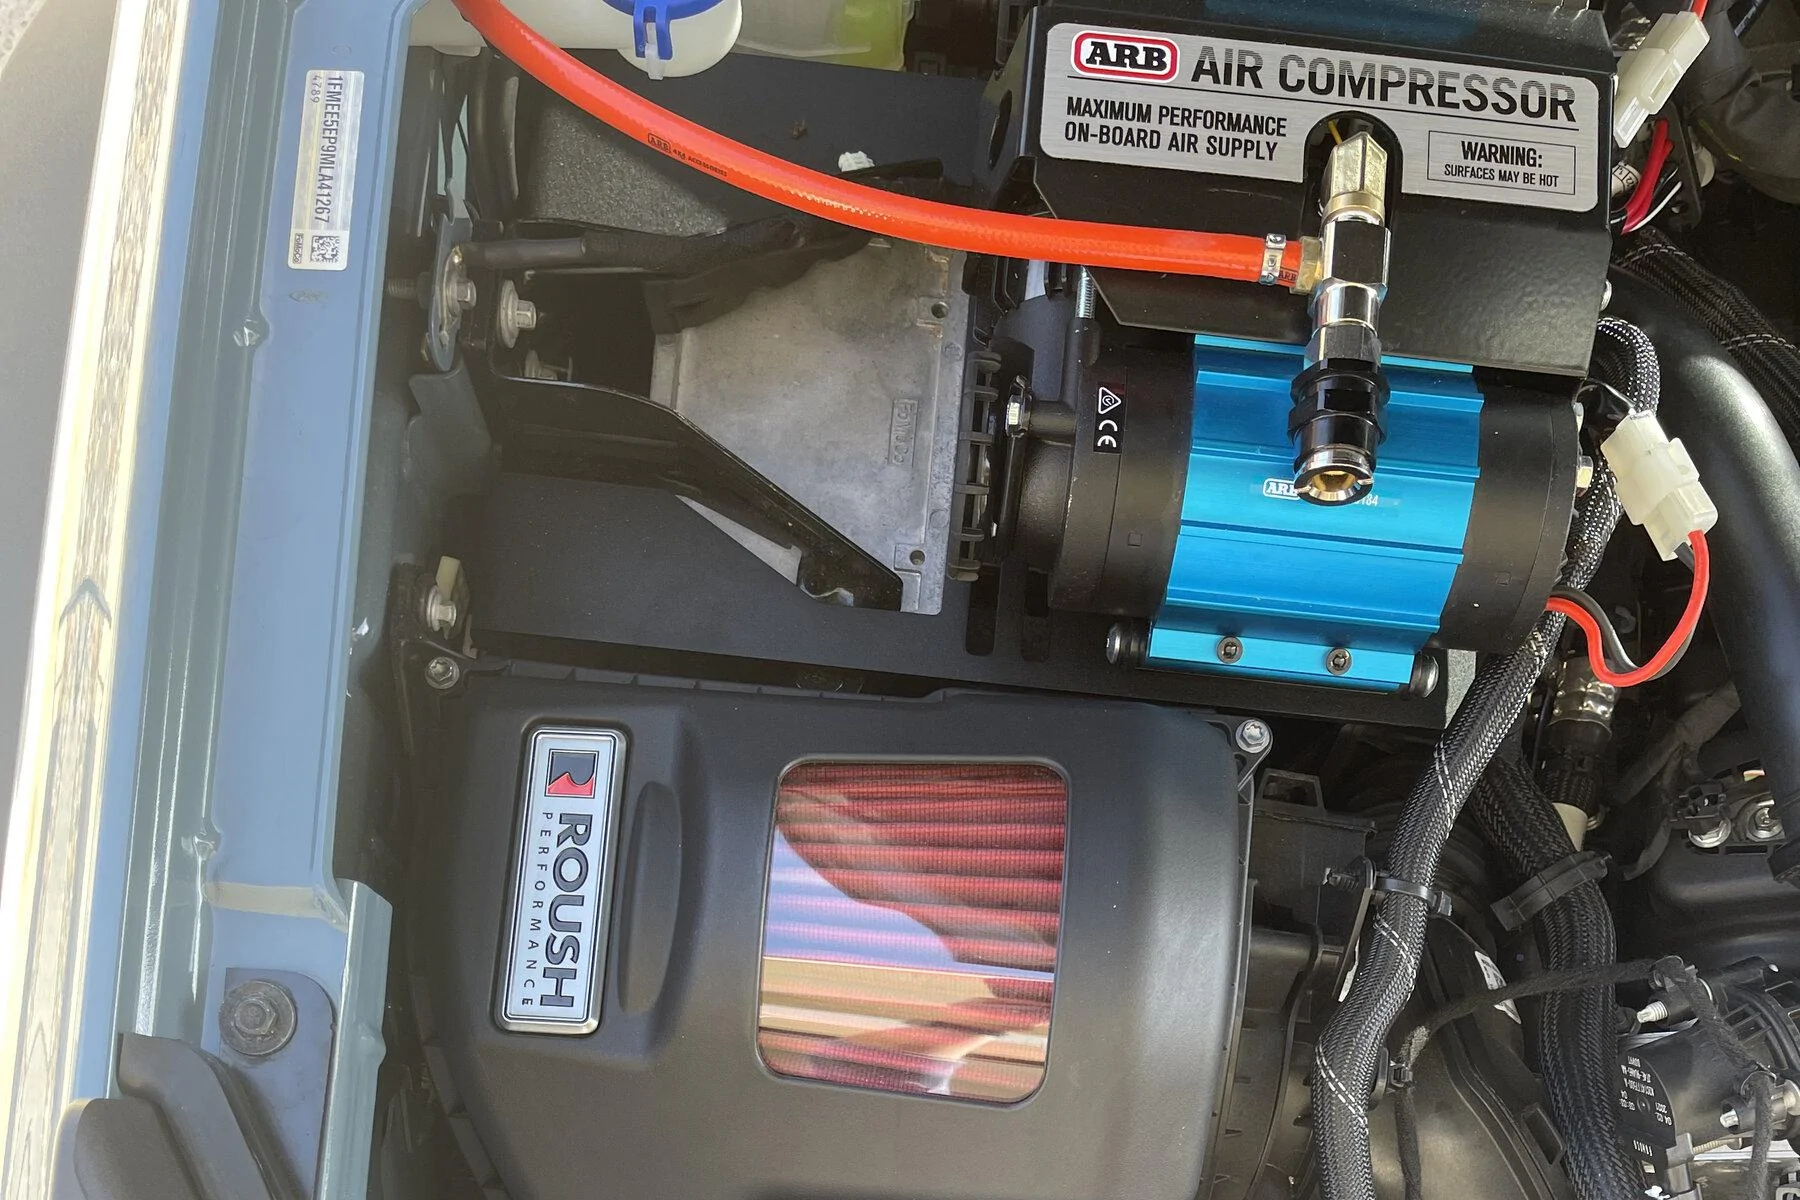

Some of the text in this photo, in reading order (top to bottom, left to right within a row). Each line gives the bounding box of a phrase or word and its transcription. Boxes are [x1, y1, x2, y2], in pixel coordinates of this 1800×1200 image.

[1086, 40, 1577, 123] ARB AIR COMPRESSOR
[1065, 121, 1278, 161] ON-BOARD AIR SUPPLY
[1066, 96, 1287, 137] MAXIMUM PERFORMANCE
[314, 76, 343, 224] 1FMEE5EP9MLA41267
[1444, 164, 1559, 188] SURFACES MAY BE HOT
[1461, 141, 1543, 168] WARNING:
[522, 811, 553, 1007] PERFORMANCE
[540, 812, 594, 1008] ROUSH
